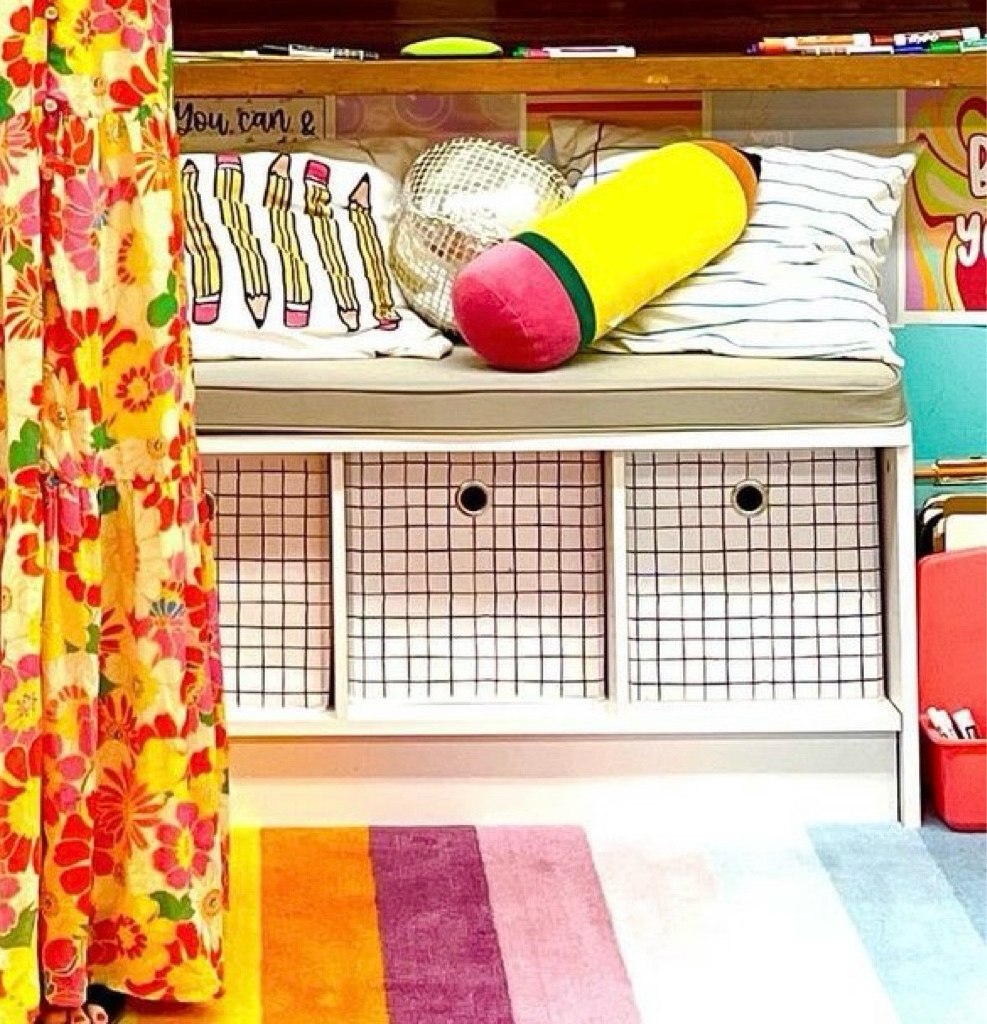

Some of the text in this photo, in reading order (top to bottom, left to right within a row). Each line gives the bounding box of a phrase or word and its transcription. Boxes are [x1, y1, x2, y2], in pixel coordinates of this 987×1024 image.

[174, 101, 316, 136] You can &
